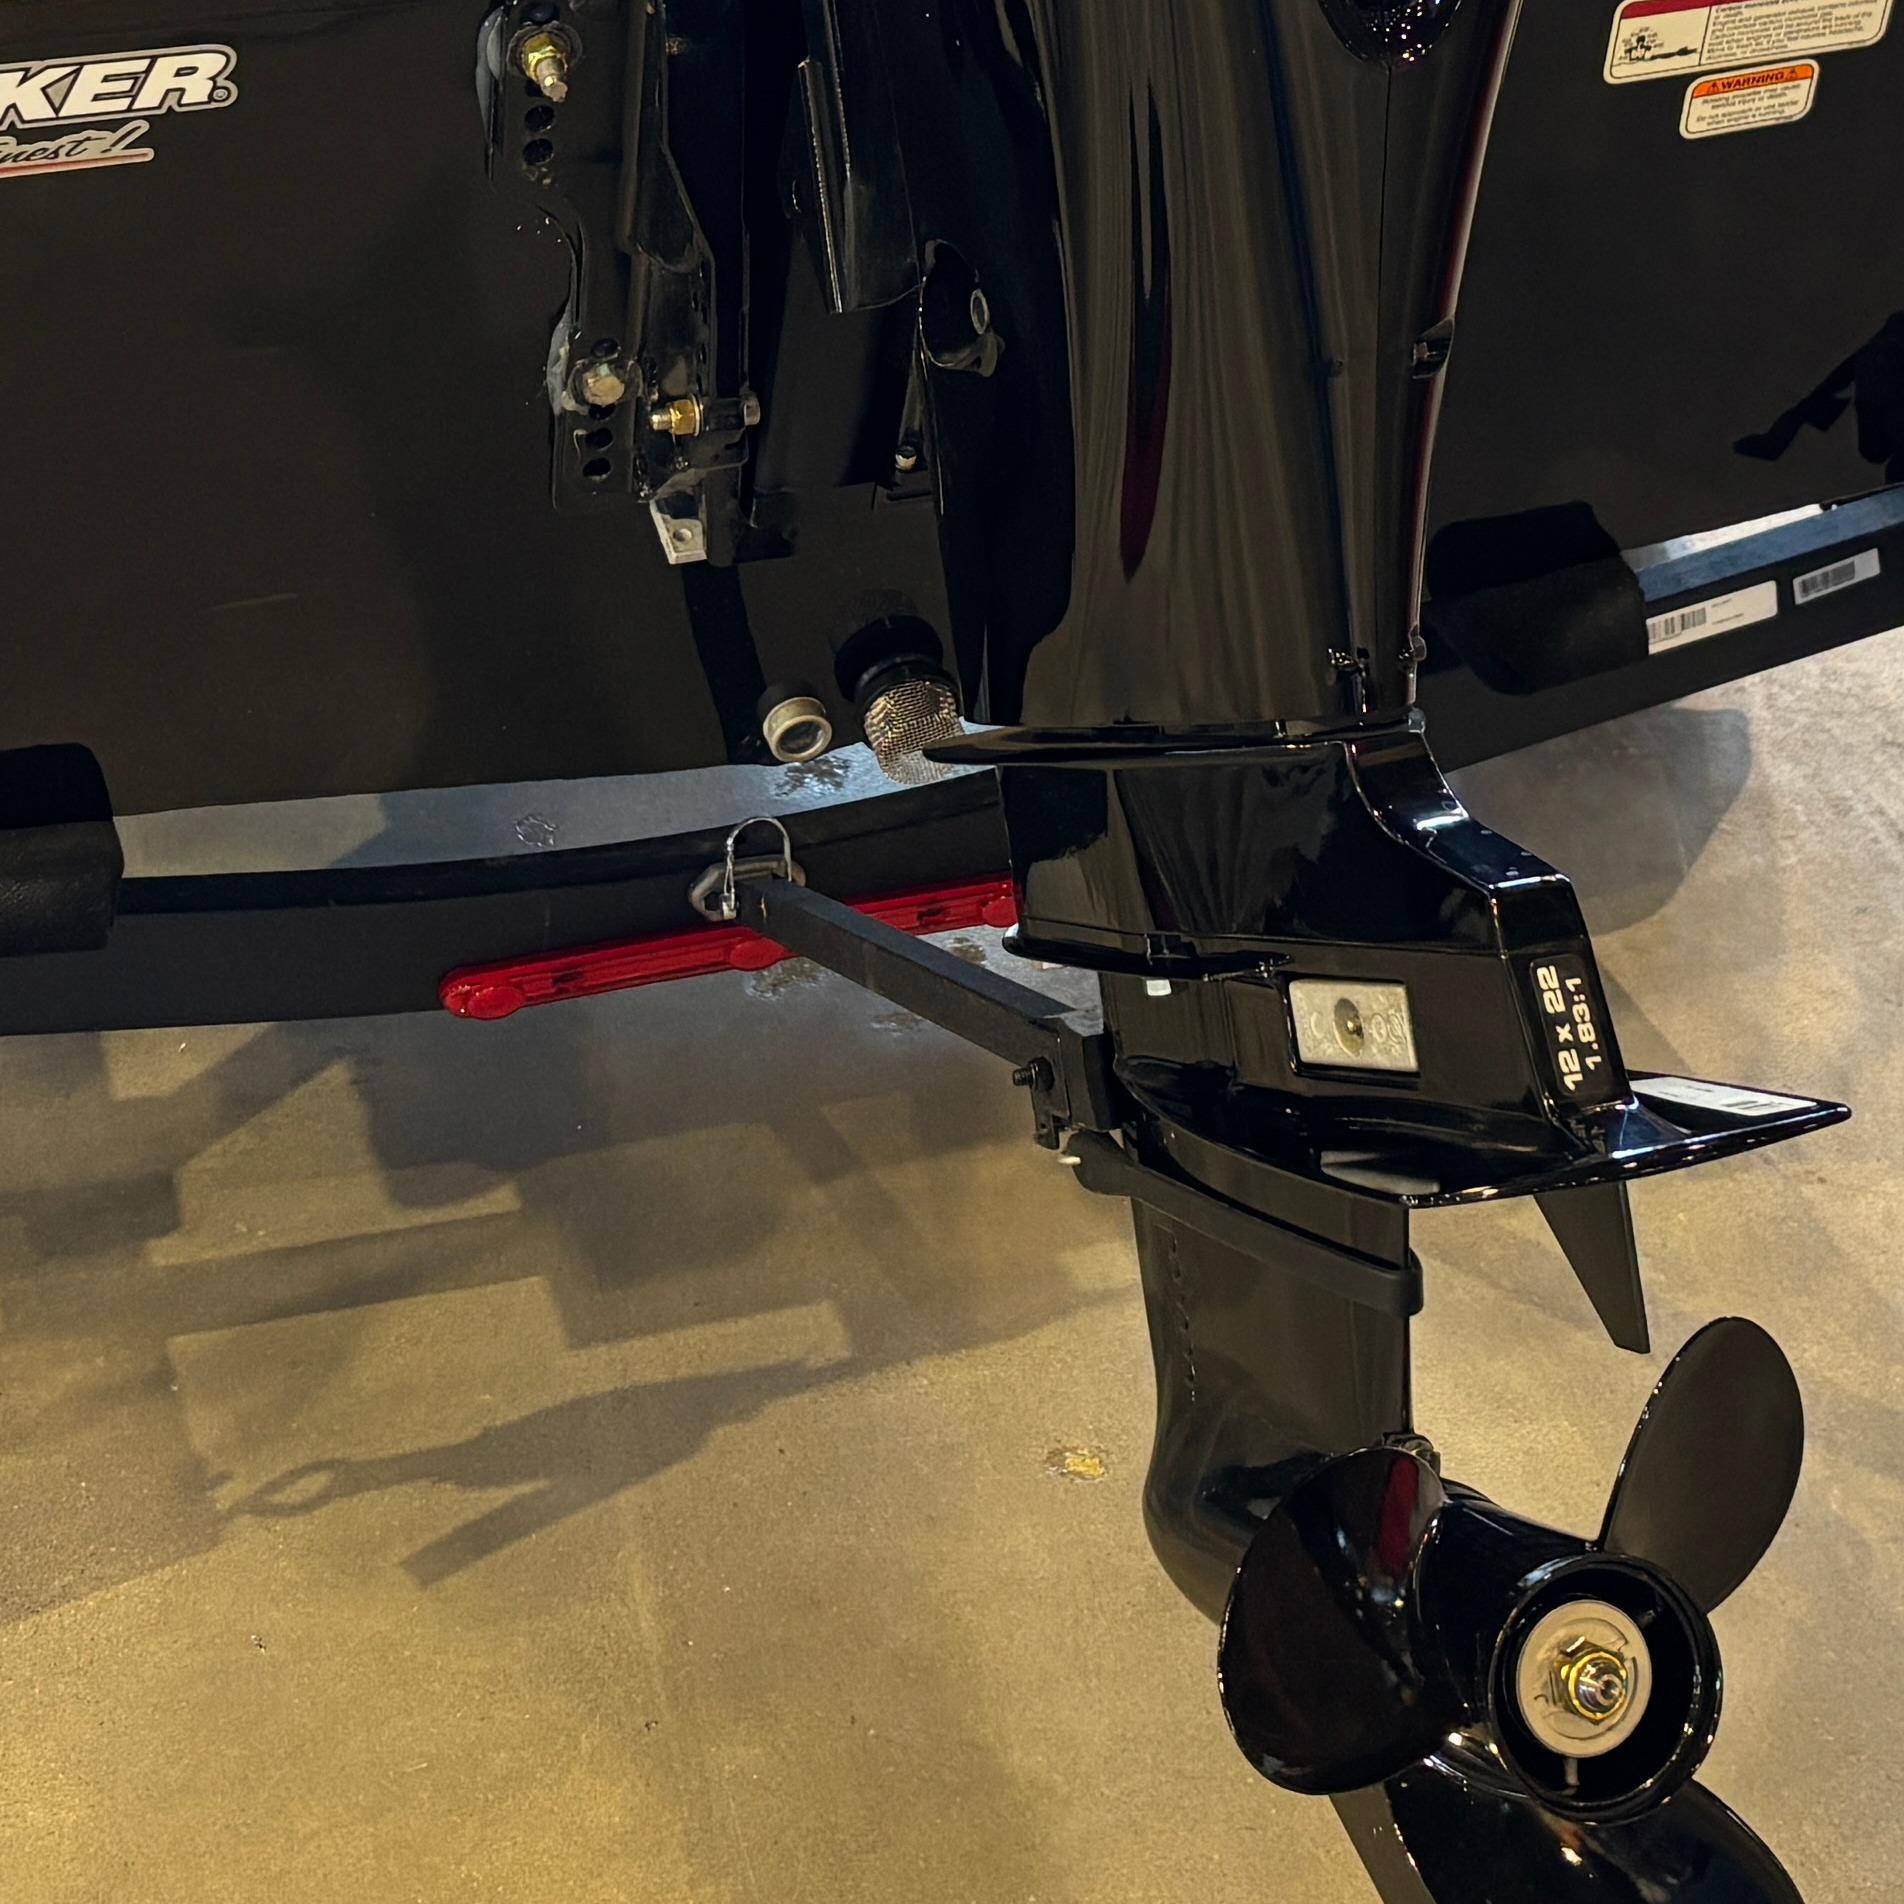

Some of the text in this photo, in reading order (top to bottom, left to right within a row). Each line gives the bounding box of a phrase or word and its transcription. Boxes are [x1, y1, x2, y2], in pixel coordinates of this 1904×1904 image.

[1721, 71, 1785, 90] WARNING
[1536, 965, 1566, 1014] 22
[1565, 977, 1602, 1071] 1.83:1
[1557, 1048, 1584, 1091] 12
